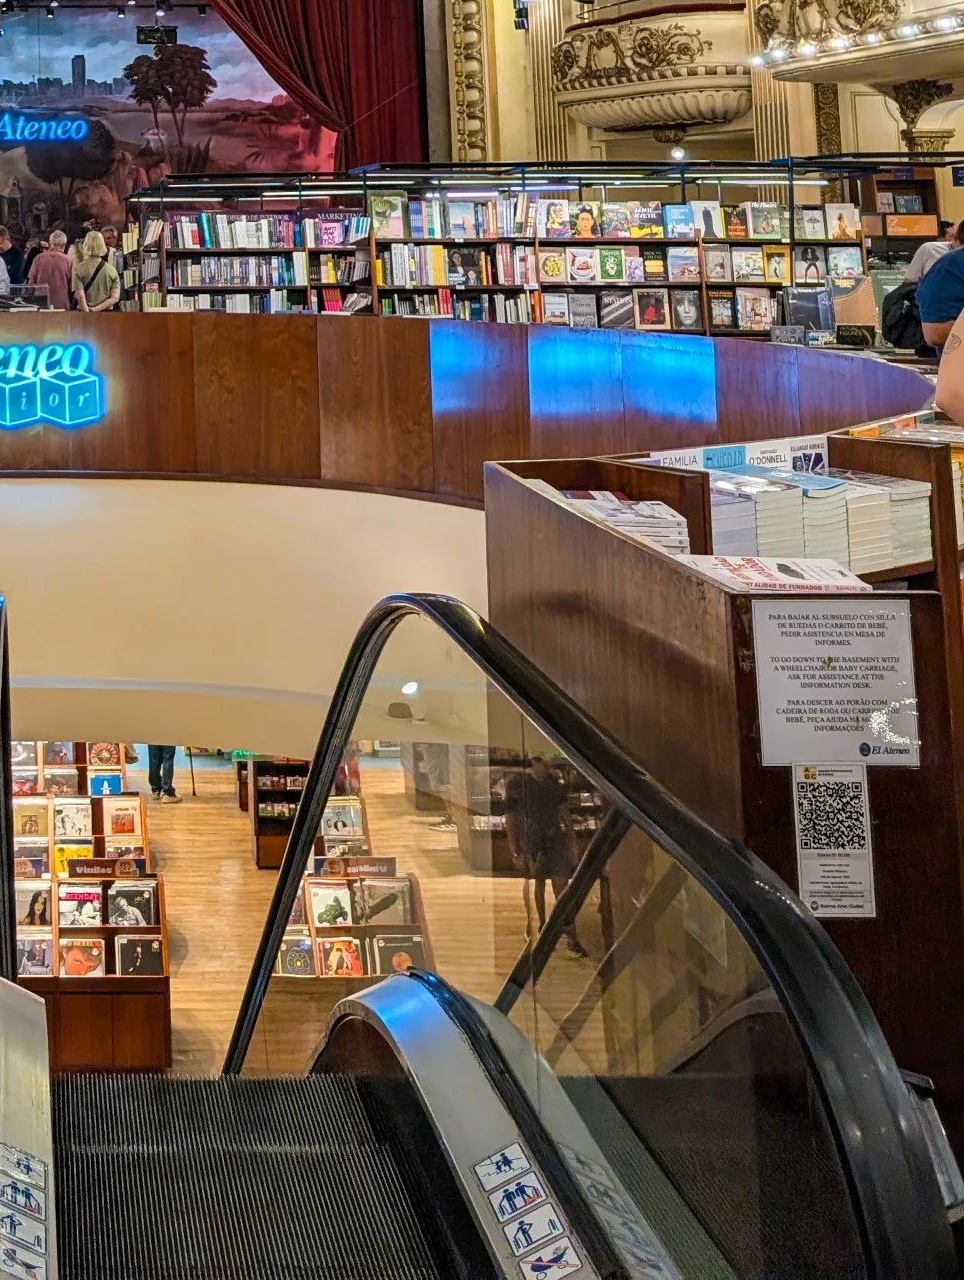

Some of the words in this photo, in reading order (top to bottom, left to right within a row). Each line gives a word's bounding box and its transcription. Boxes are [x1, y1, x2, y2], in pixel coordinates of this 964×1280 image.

[662, 455, 698, 467] FAMILIA
[749, 454, 788, 465] O'DONNELL
[872, 745, 882, 755] El
[882, 745, 910, 755] Ateneo
